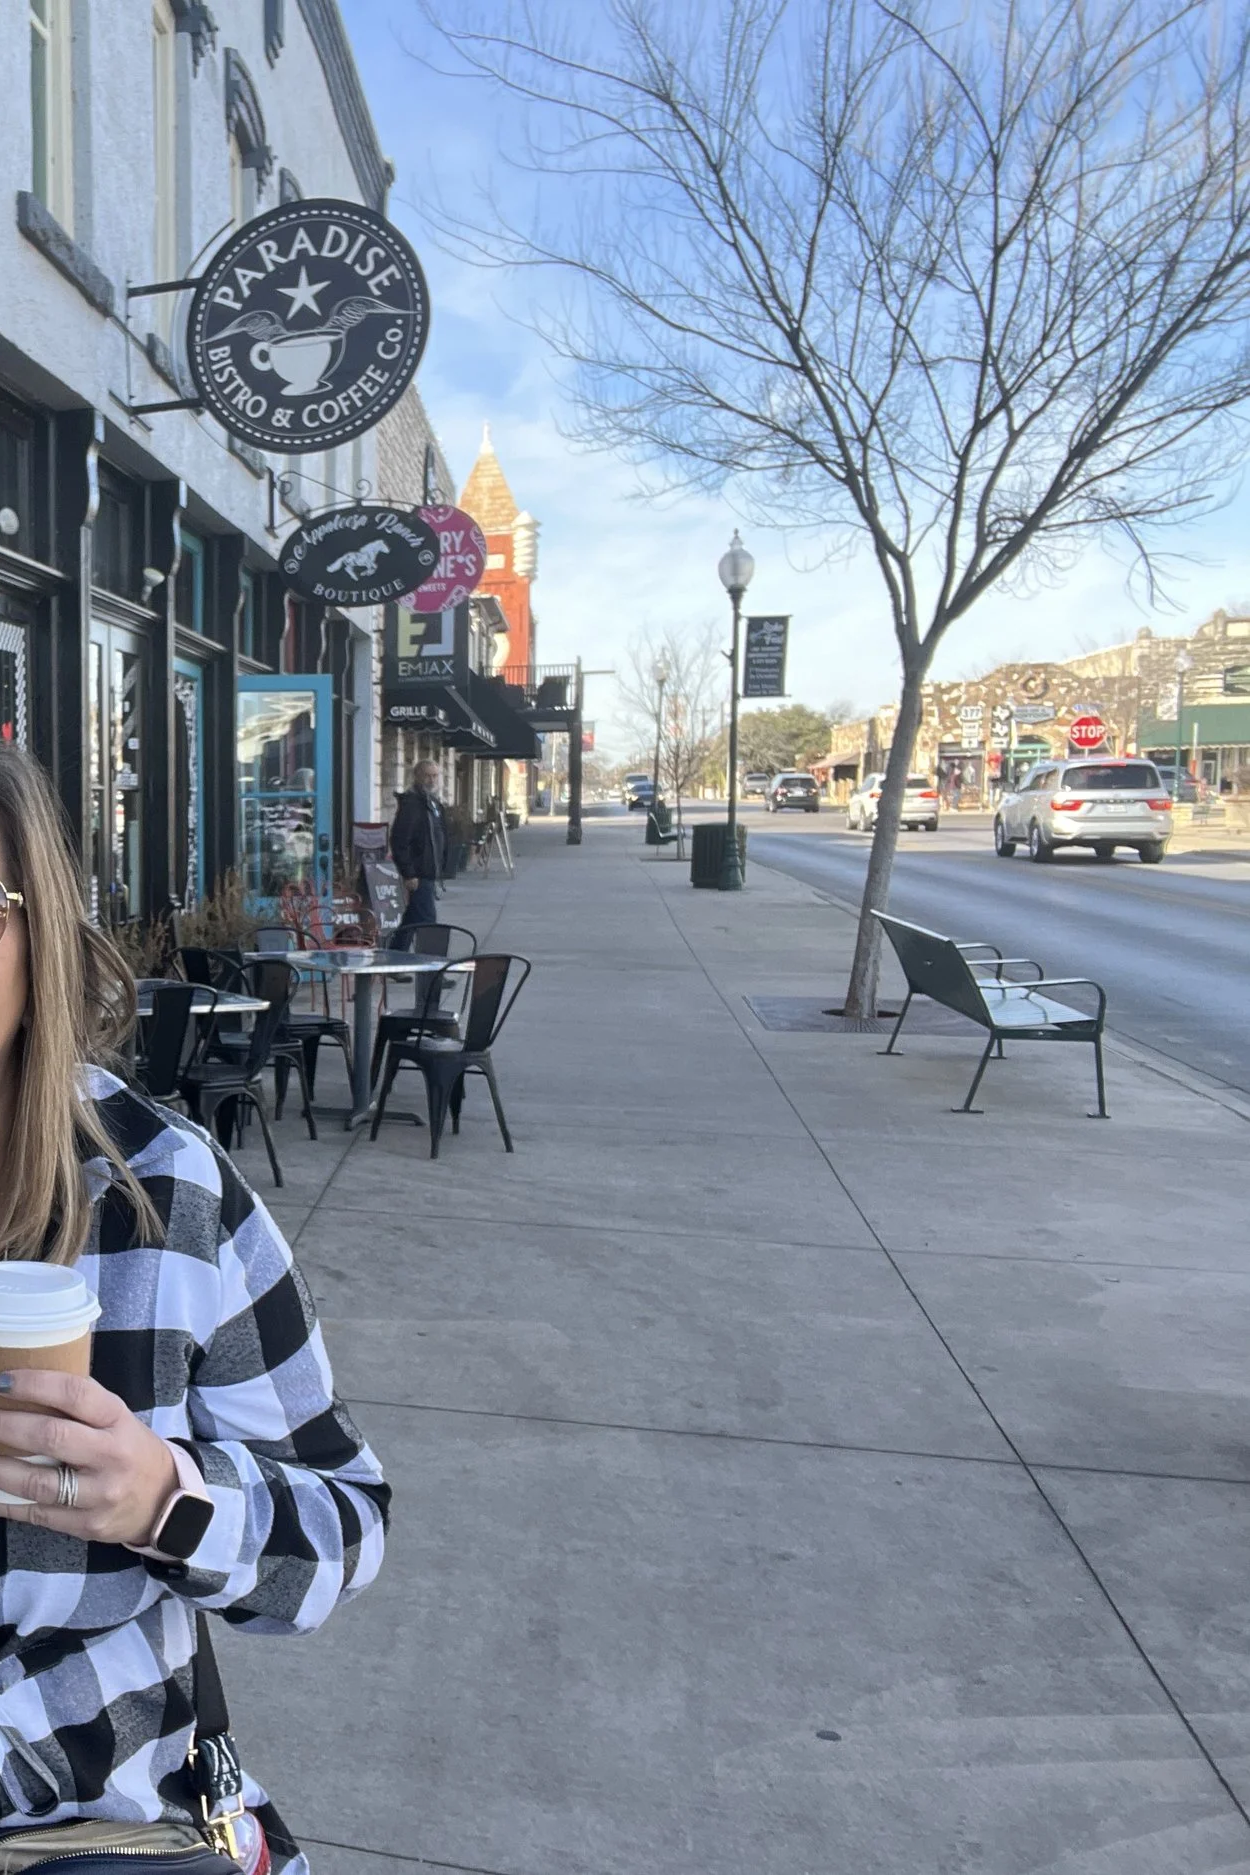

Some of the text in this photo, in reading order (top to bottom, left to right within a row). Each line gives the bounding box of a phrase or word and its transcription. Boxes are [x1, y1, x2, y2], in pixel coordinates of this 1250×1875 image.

[212, 225, 402, 311] PARADISE
[207, 345, 268, 419] BISTRO
[270, 407, 296, 429] &
[301, 363, 390, 428] COFFEE
[437, 530, 465, 553] RY
[431, 554, 477, 579] NE'S
[312, 577, 406, 603] BOUTIQUE
[397, 659, 454, 675] EMJAX
[390, 705, 428, 718] GRILLE
[962, 707, 982, 719] 377
[1071, 725, 1106, 739] STOP
